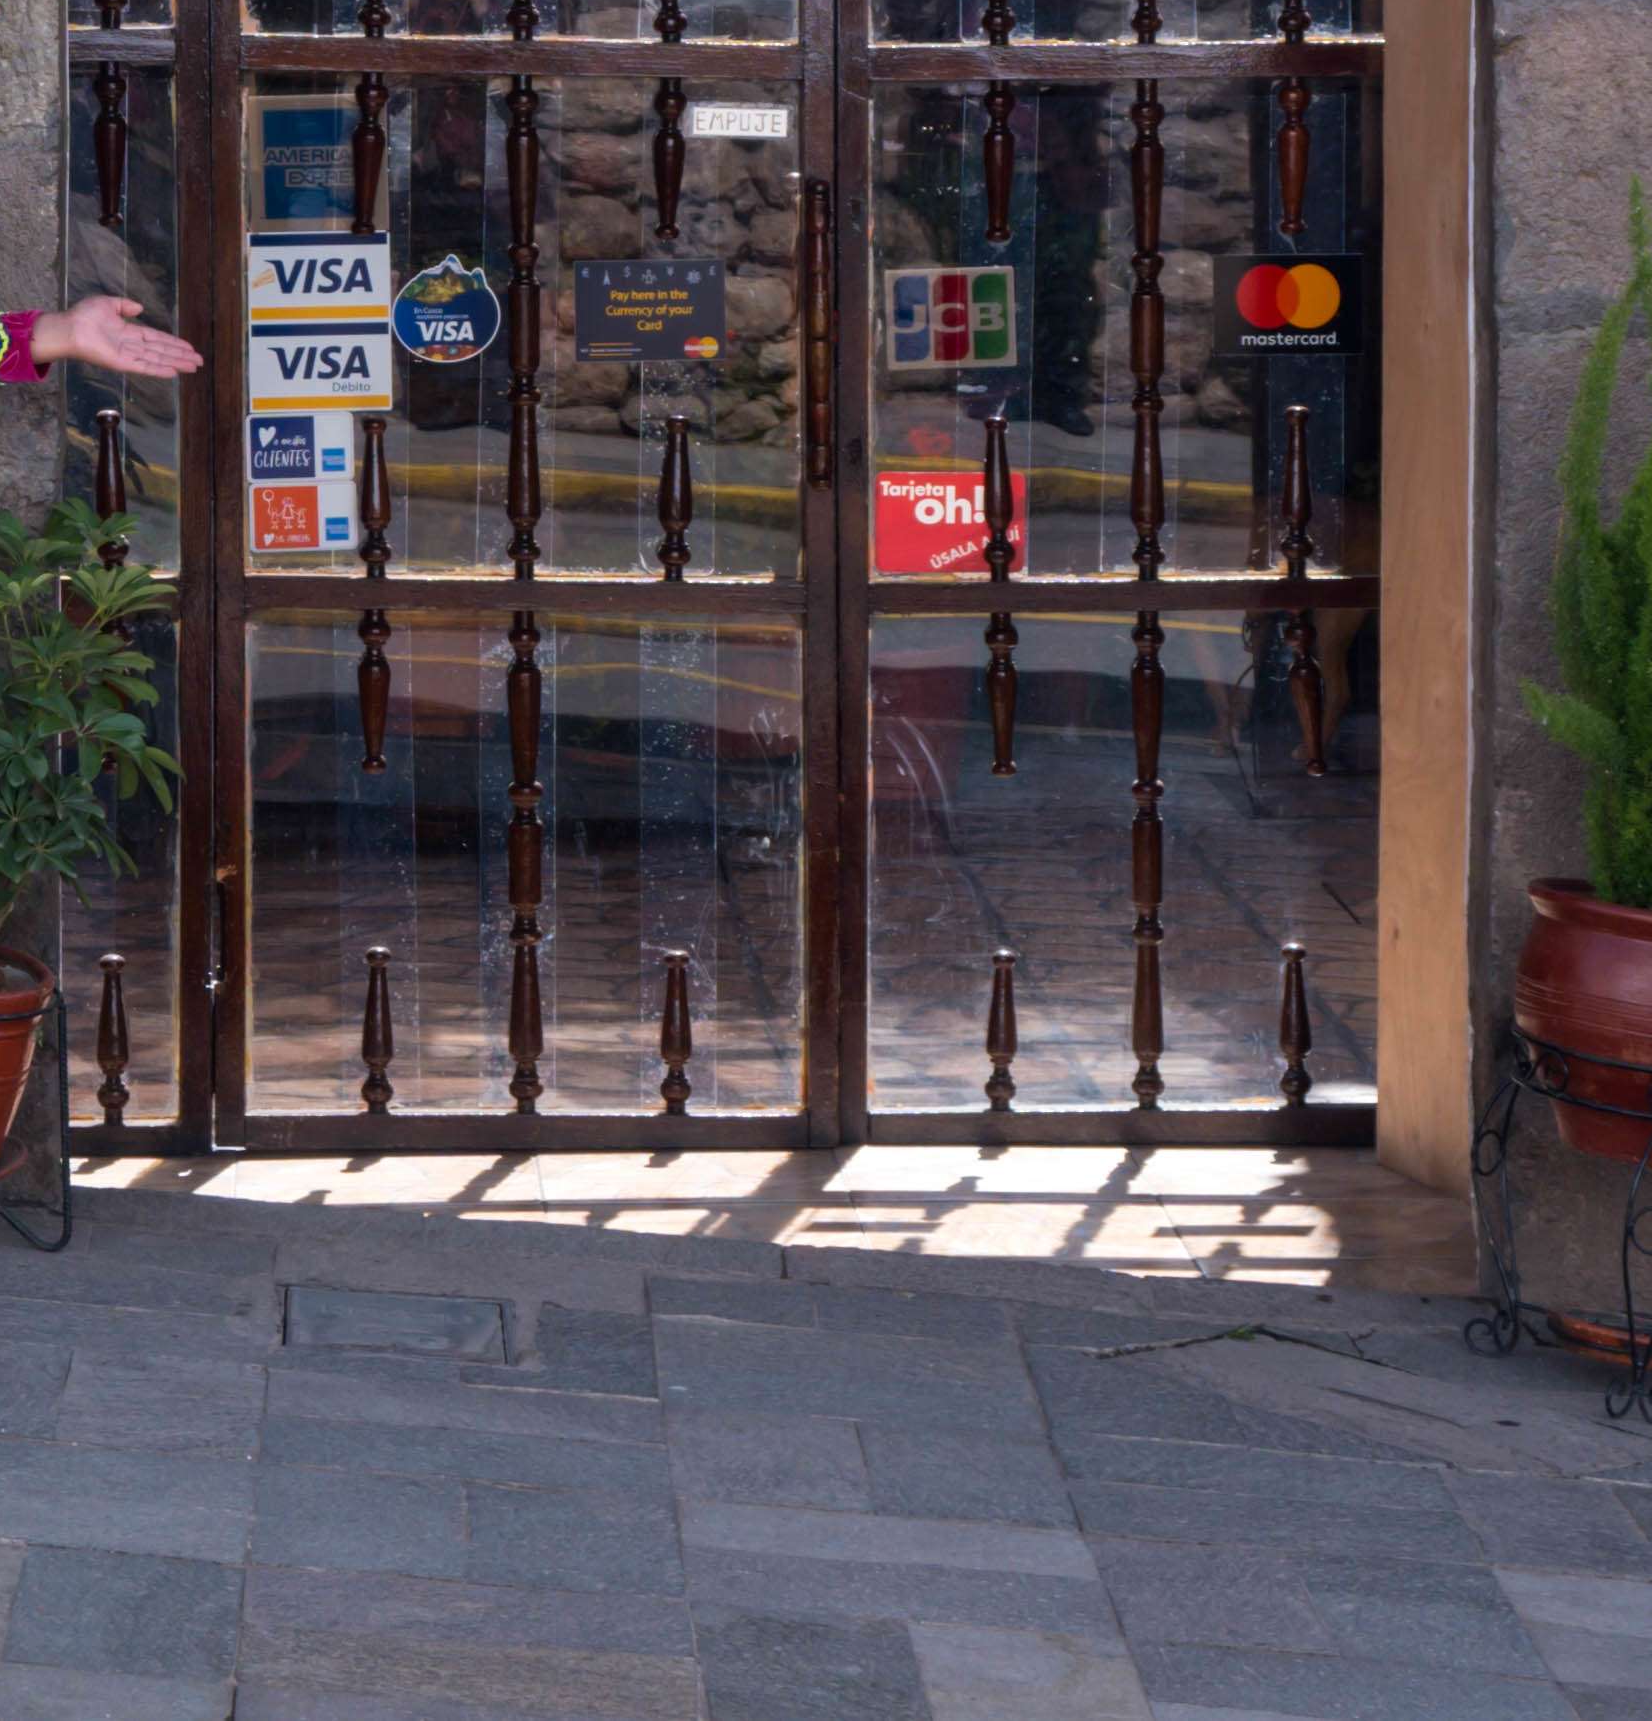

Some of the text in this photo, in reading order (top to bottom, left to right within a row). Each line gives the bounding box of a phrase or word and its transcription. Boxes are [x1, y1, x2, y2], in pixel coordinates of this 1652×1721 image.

[695, 110, 781, 133] EMPUJE
[264, 147, 353, 166] AMERICA
[285, 168, 354, 187] EXPRE
[264, 258, 373, 294] VISA
[610, 288, 689, 303] Pay here in the
[605, 304, 694, 318] Currency of your
[891, 302, 1005, 333] JCB
[414, 320, 475, 342] VISA
[637, 319, 663, 331] Card
[1241, 331, 1337, 346] mastercard
[267, 345, 370, 380] VISA
[254, 448, 310, 468] CLIENTES
[880, 480, 945, 501] Tarjeta
[914, 485, 985, 525] oh!
[981, 525, 1020, 549] AUÍ
[929, 540, 979, 570] ÚSALA
